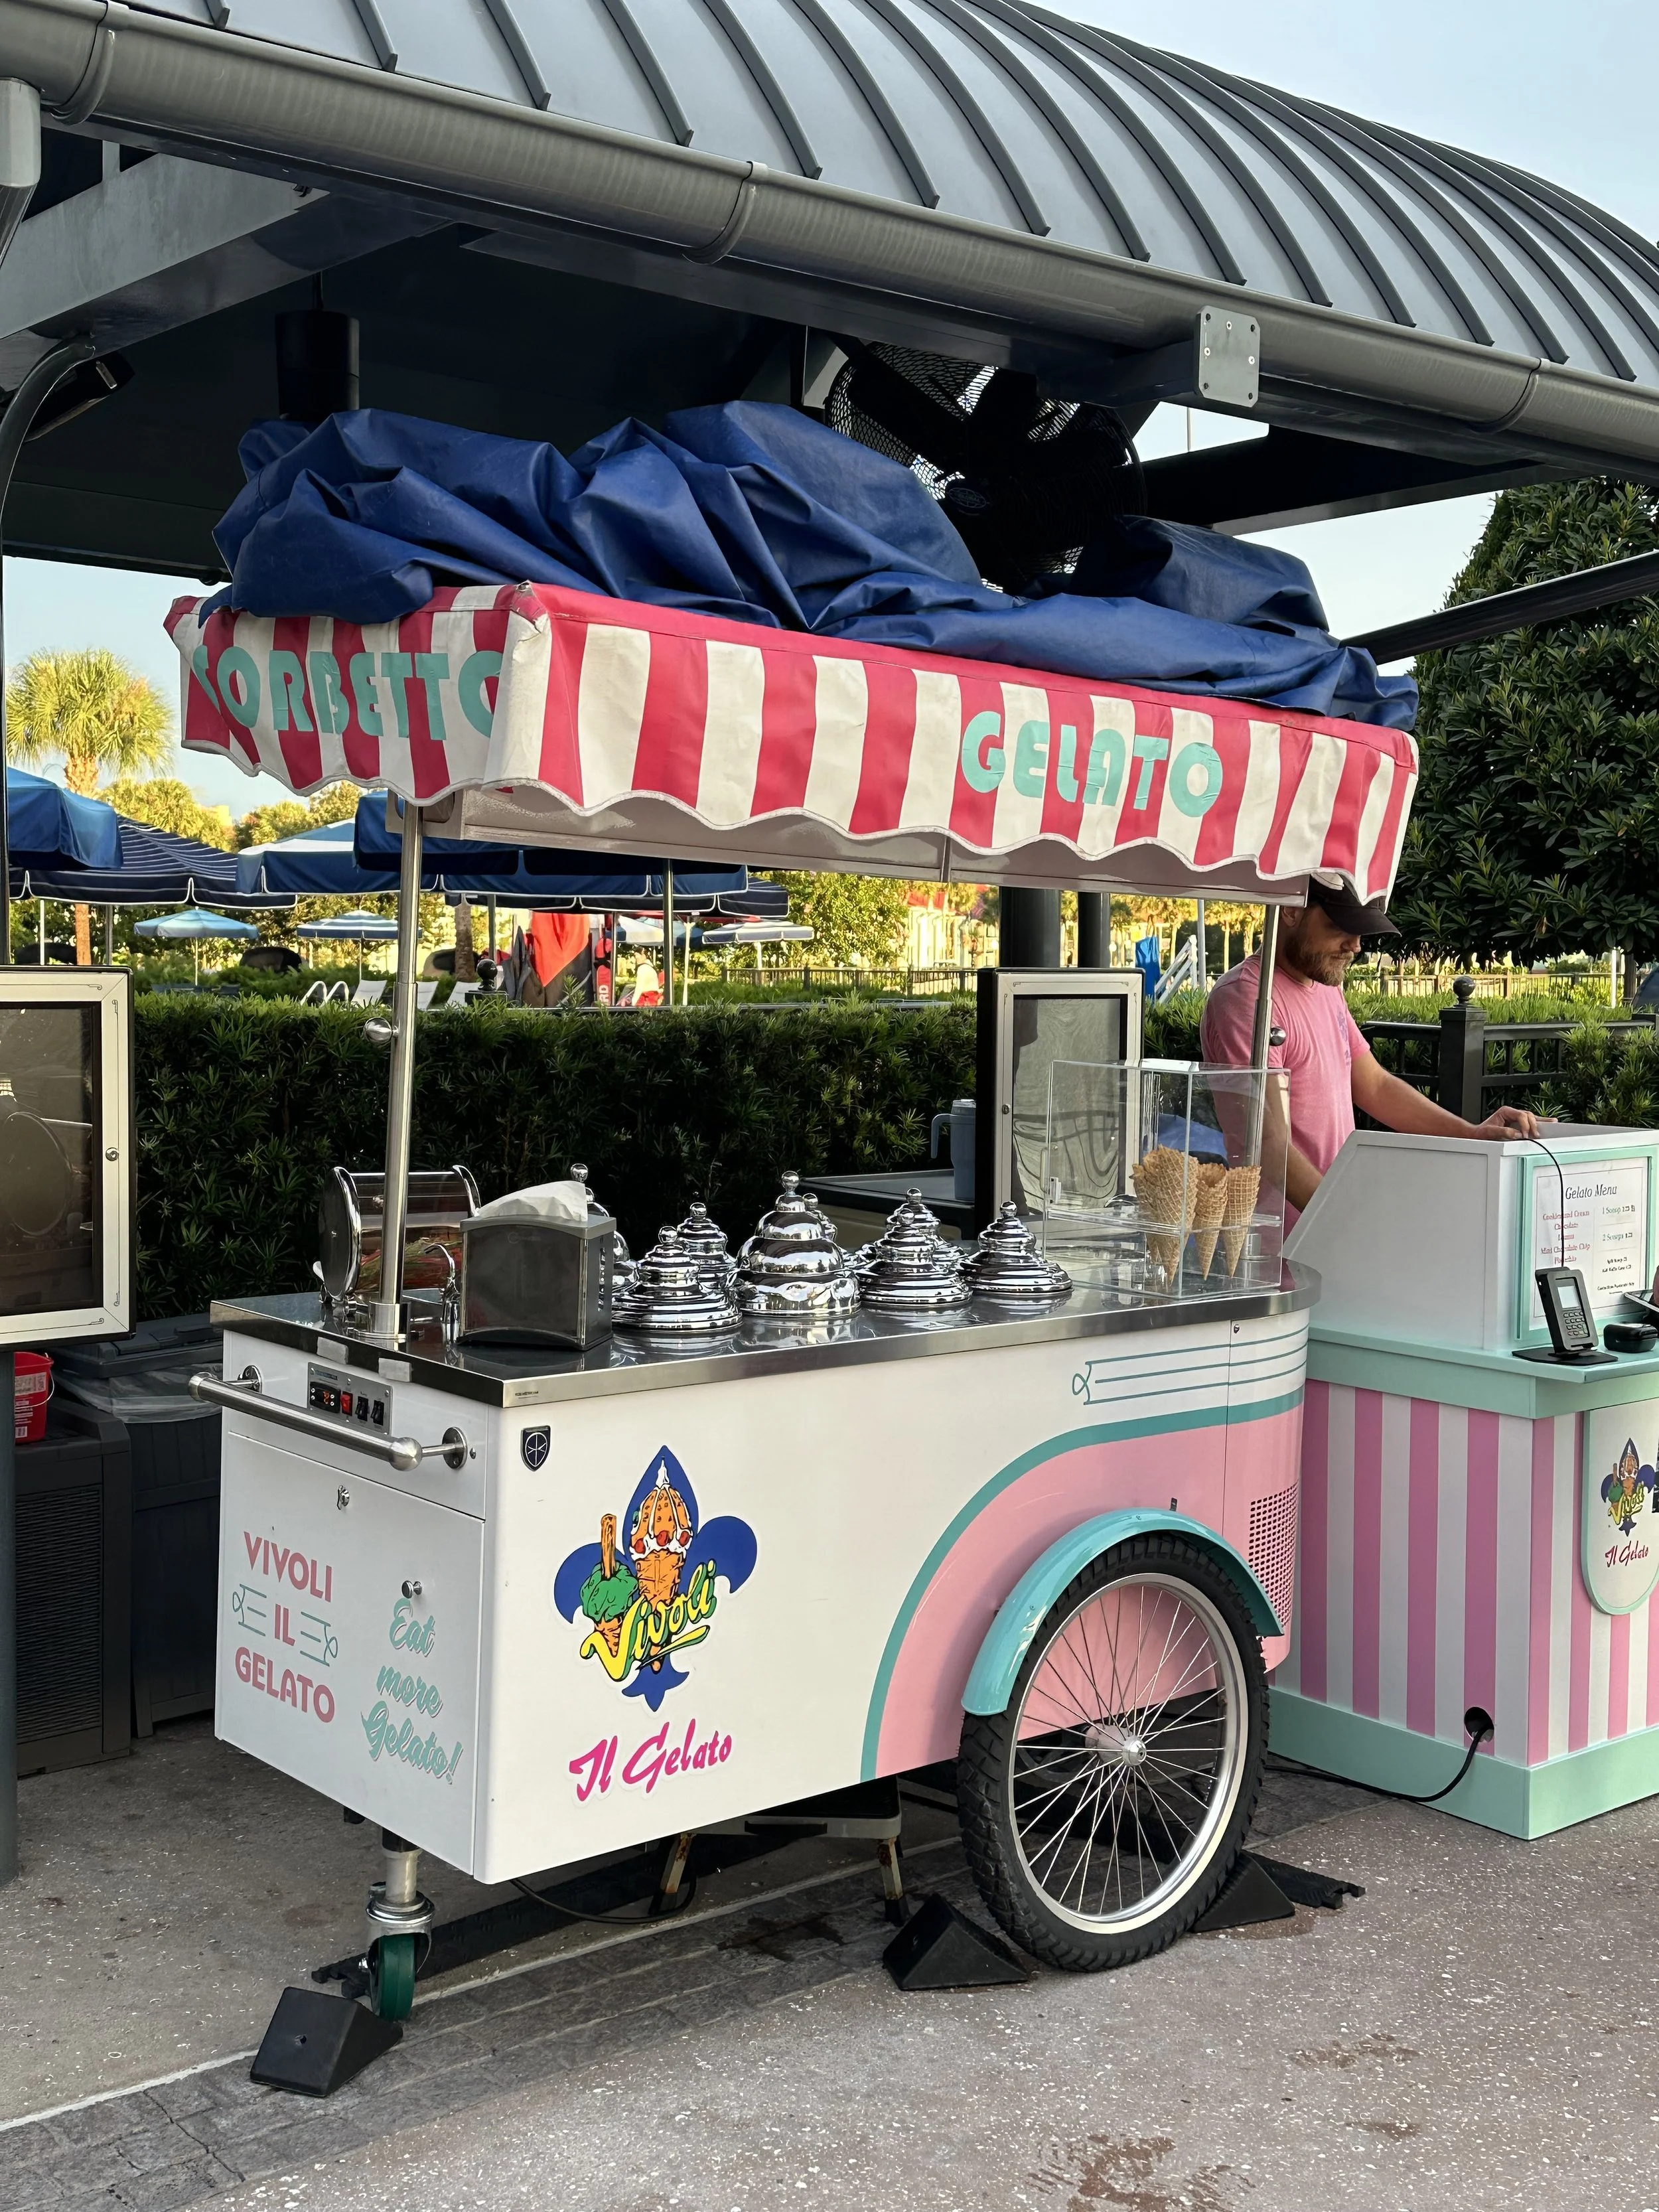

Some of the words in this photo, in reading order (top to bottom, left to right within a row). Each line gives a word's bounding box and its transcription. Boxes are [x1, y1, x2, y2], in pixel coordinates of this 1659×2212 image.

[962, 711, 1223, 818] GELATO
[1565, 1186, 1593, 1200] Gelato
[1594, 1184, 1617, 1197] Menu
[244, 1530, 332, 1603] VIVOLI
[274, 1603, 296, 1646] IL
[389, 1597, 436, 1657] Eat
[579, 1558, 716, 1682] Vivoli
[235, 1647, 335, 1723] GELATO
[376, 1665, 444, 1718] more
[362, 1700, 464, 1785] Gelato!
[569, 1735, 618, 1802] Il
[622, 1719, 732, 1793] Gelato
